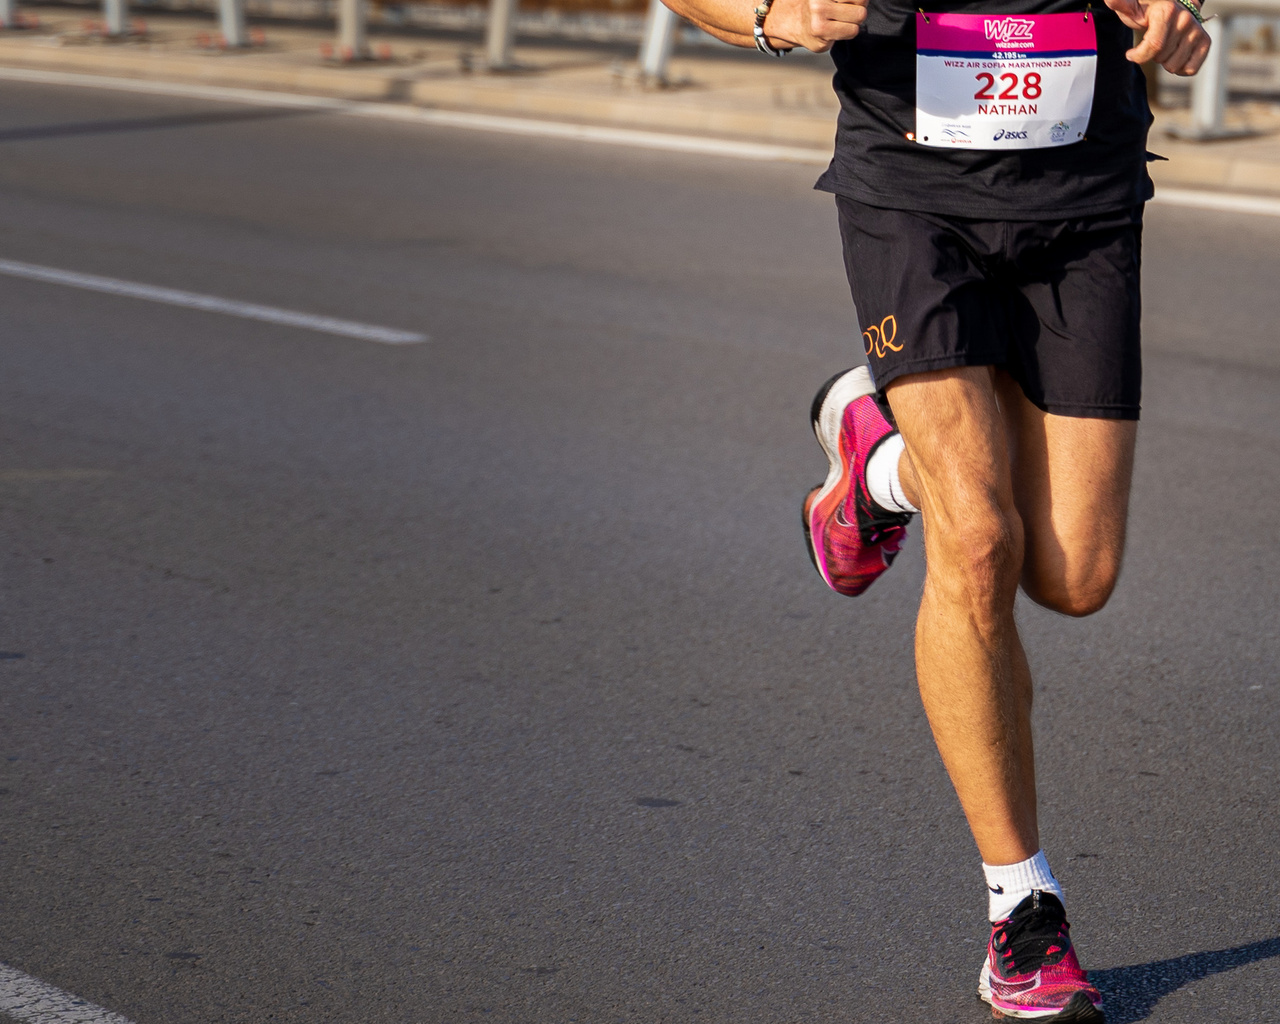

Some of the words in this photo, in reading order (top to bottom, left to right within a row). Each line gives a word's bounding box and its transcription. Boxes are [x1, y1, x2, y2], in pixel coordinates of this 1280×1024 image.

[995, 41, 1035, 49] wizzair.com
[992, 51, 1017, 60] 42.195
[944, 60, 964, 68] WIZZ
[966, 60, 980, 69] AIR
[982, 60, 1006, 69] SOFIA
[1008, 60, 1052, 69] MARATHON
[974, 72, 1042, 100] 228
[978, 104, 1038, 115] NATHAN
